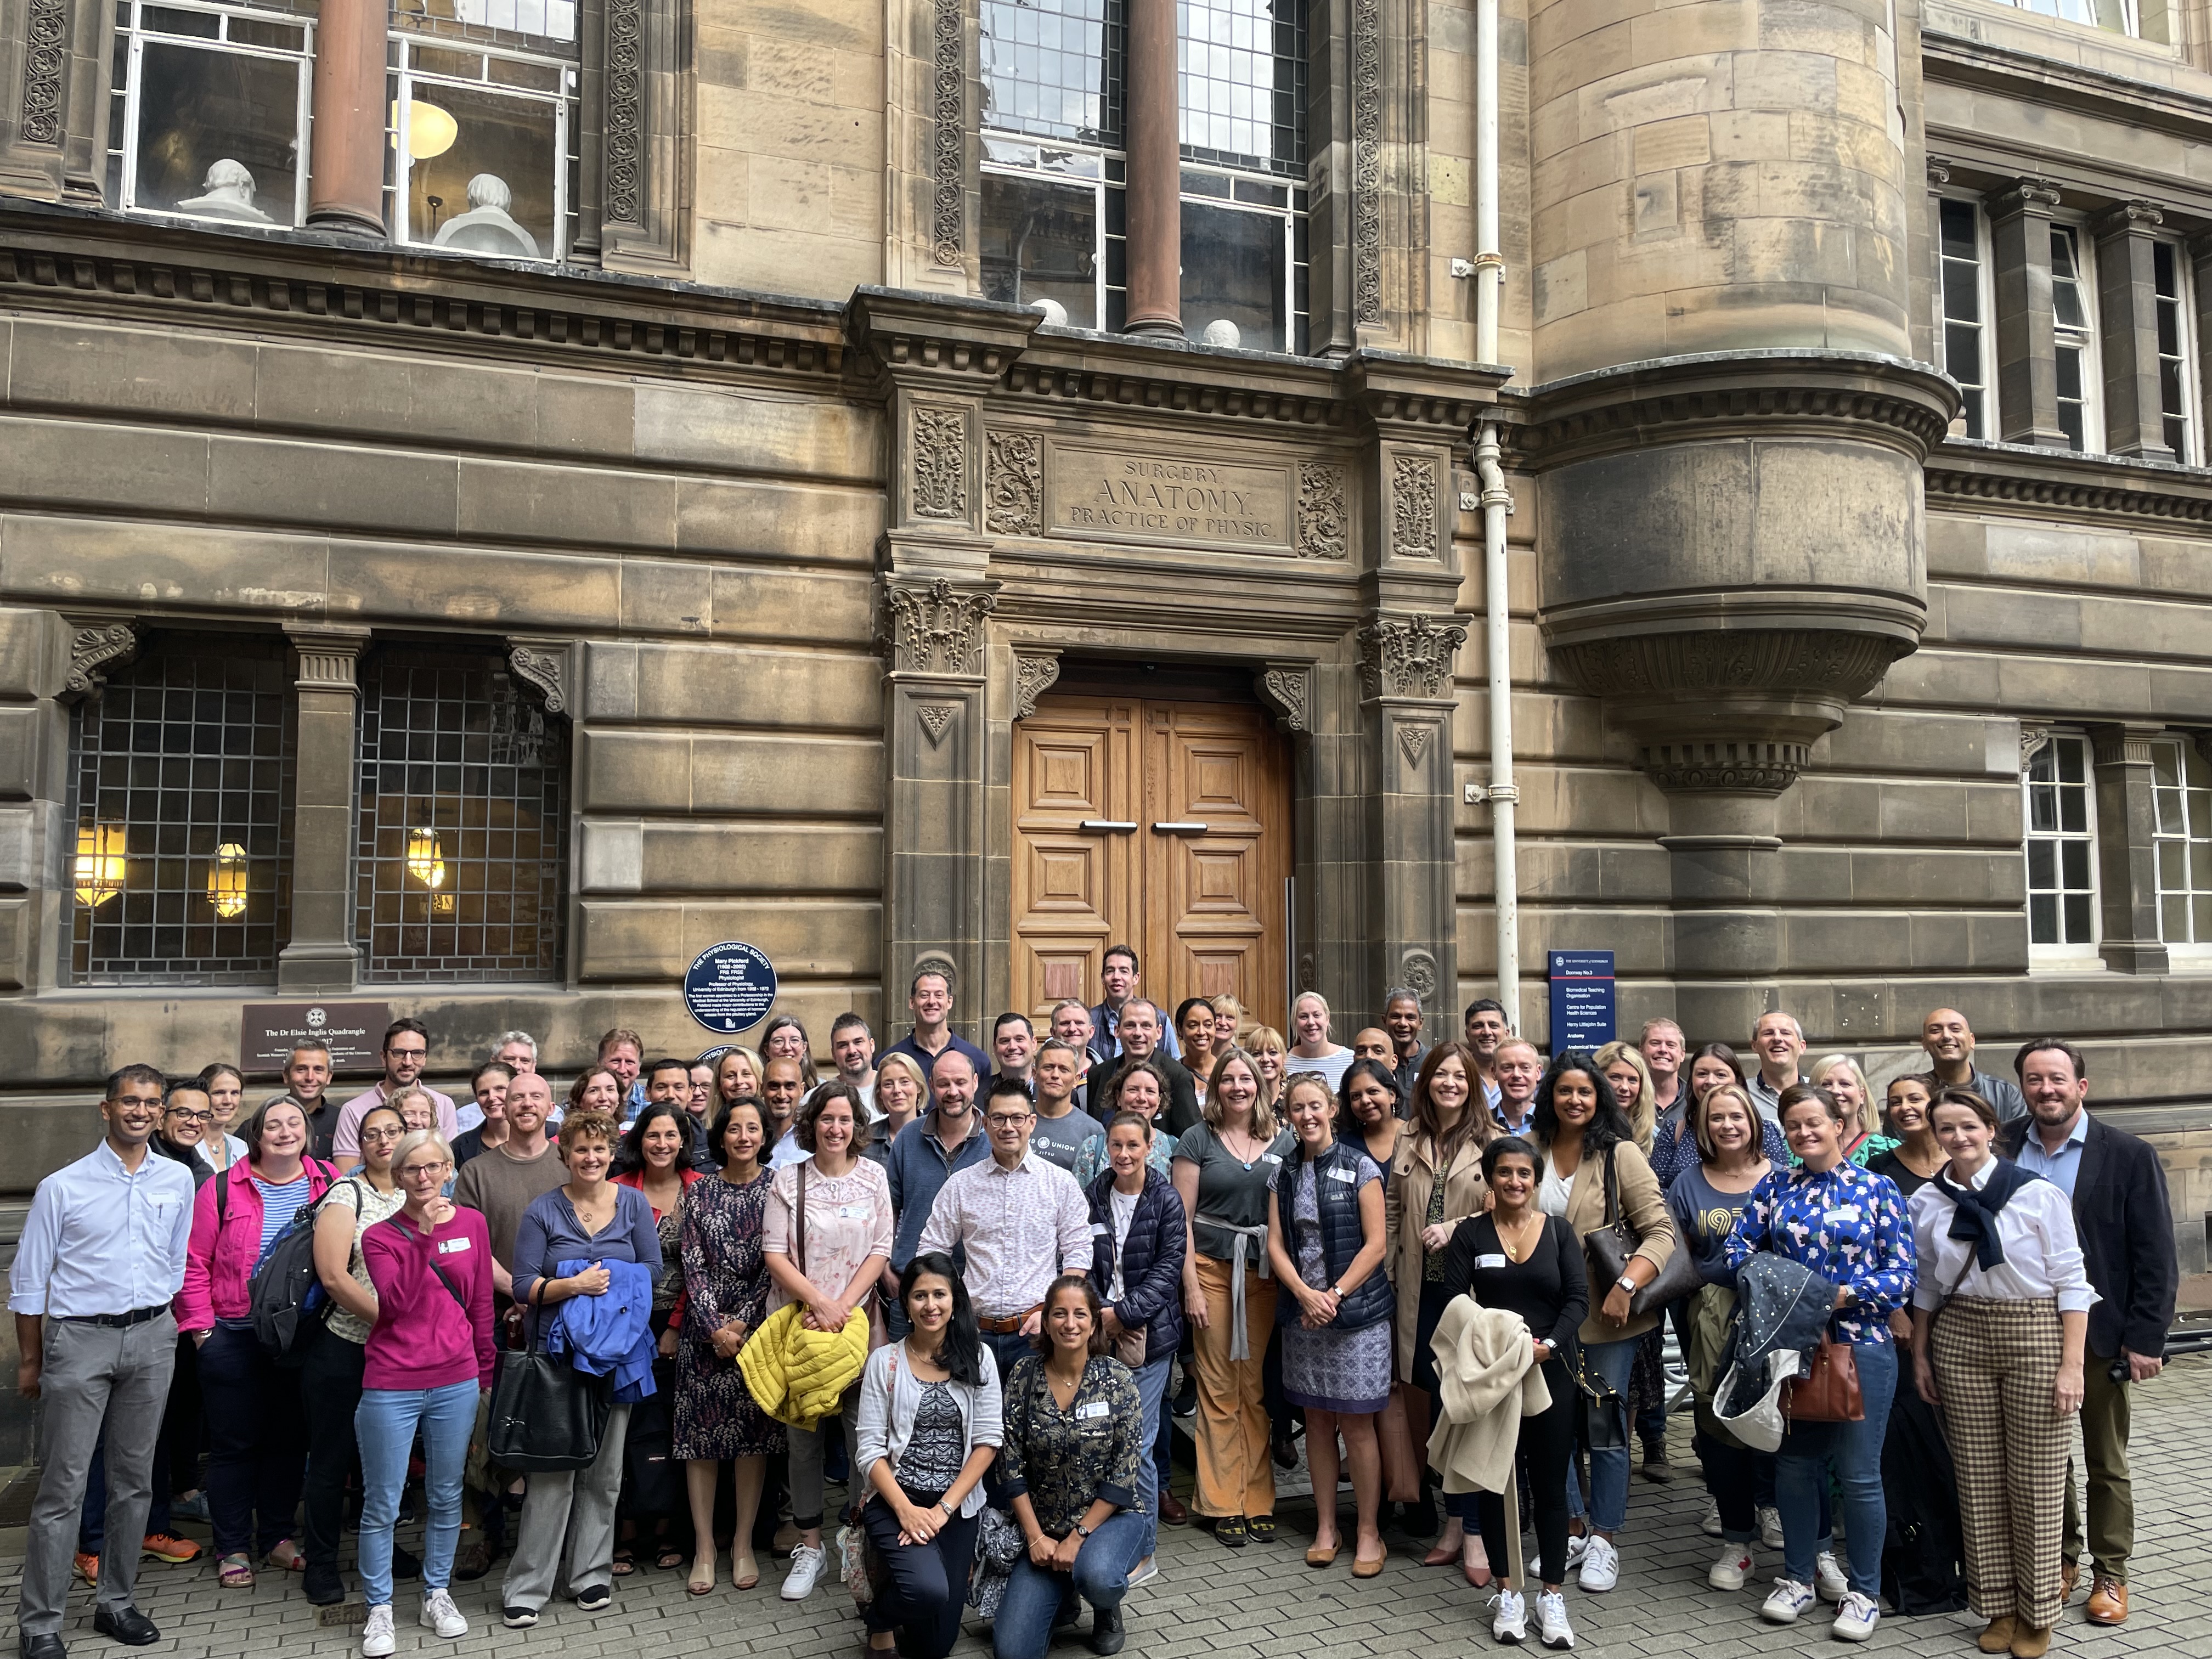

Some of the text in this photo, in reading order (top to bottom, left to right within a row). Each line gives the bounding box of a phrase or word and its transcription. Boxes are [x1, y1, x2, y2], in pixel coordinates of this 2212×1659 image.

[1070, 507, 1168, 529] PRACTICE
[1176, 516, 1198, 531] OF
[693, 944, 770, 970] THE PHYSIOLOGICAL SOCIETY
[308, 1029, 327, 1037] Inglis
[328, 1028, 366, 1036] Quadrangle
[1051, 1141, 1075, 1152] UNION
